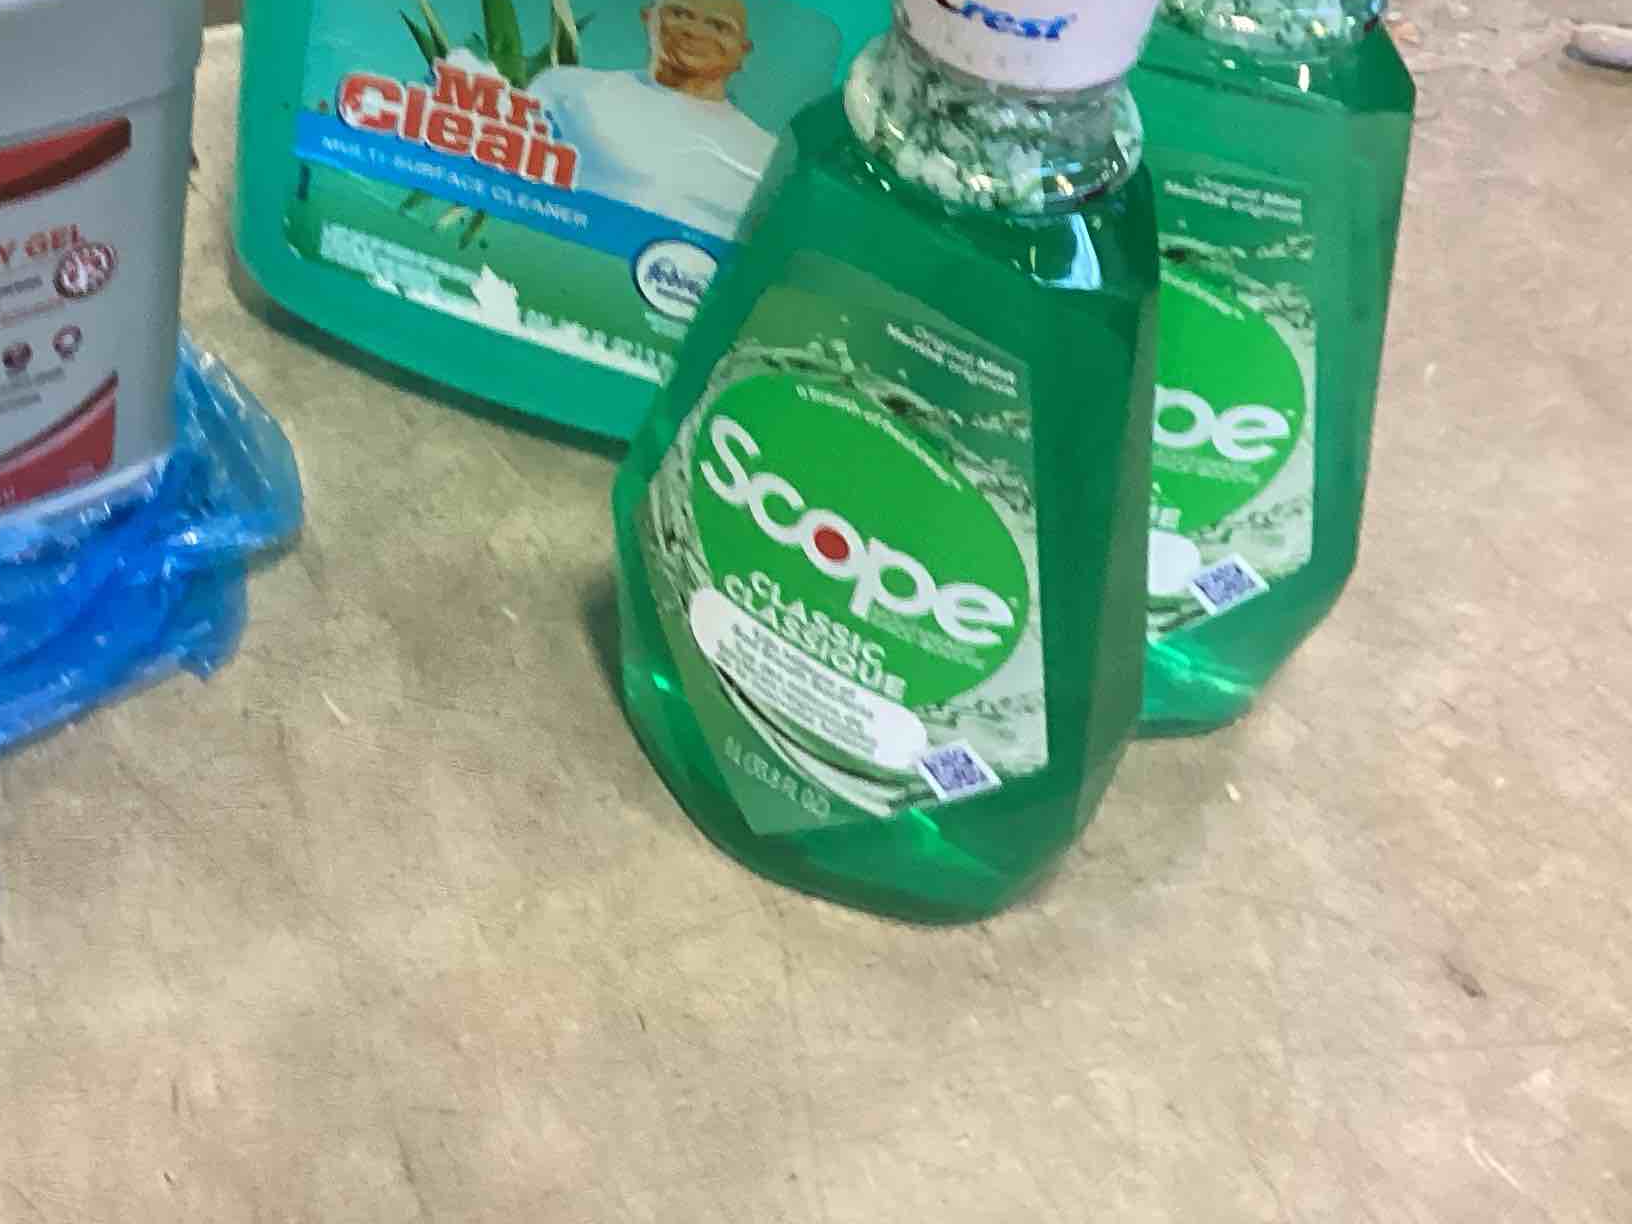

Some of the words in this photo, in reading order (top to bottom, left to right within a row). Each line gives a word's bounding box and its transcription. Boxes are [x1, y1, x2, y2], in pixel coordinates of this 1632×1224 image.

[337, 73, 581, 190] Clean
[432, 61, 551, 138] Mr.
[23, 223, 80, 258] GEL
[491, 184, 589, 230] CLEANER
[700, 415, 1015, 647] Scope
